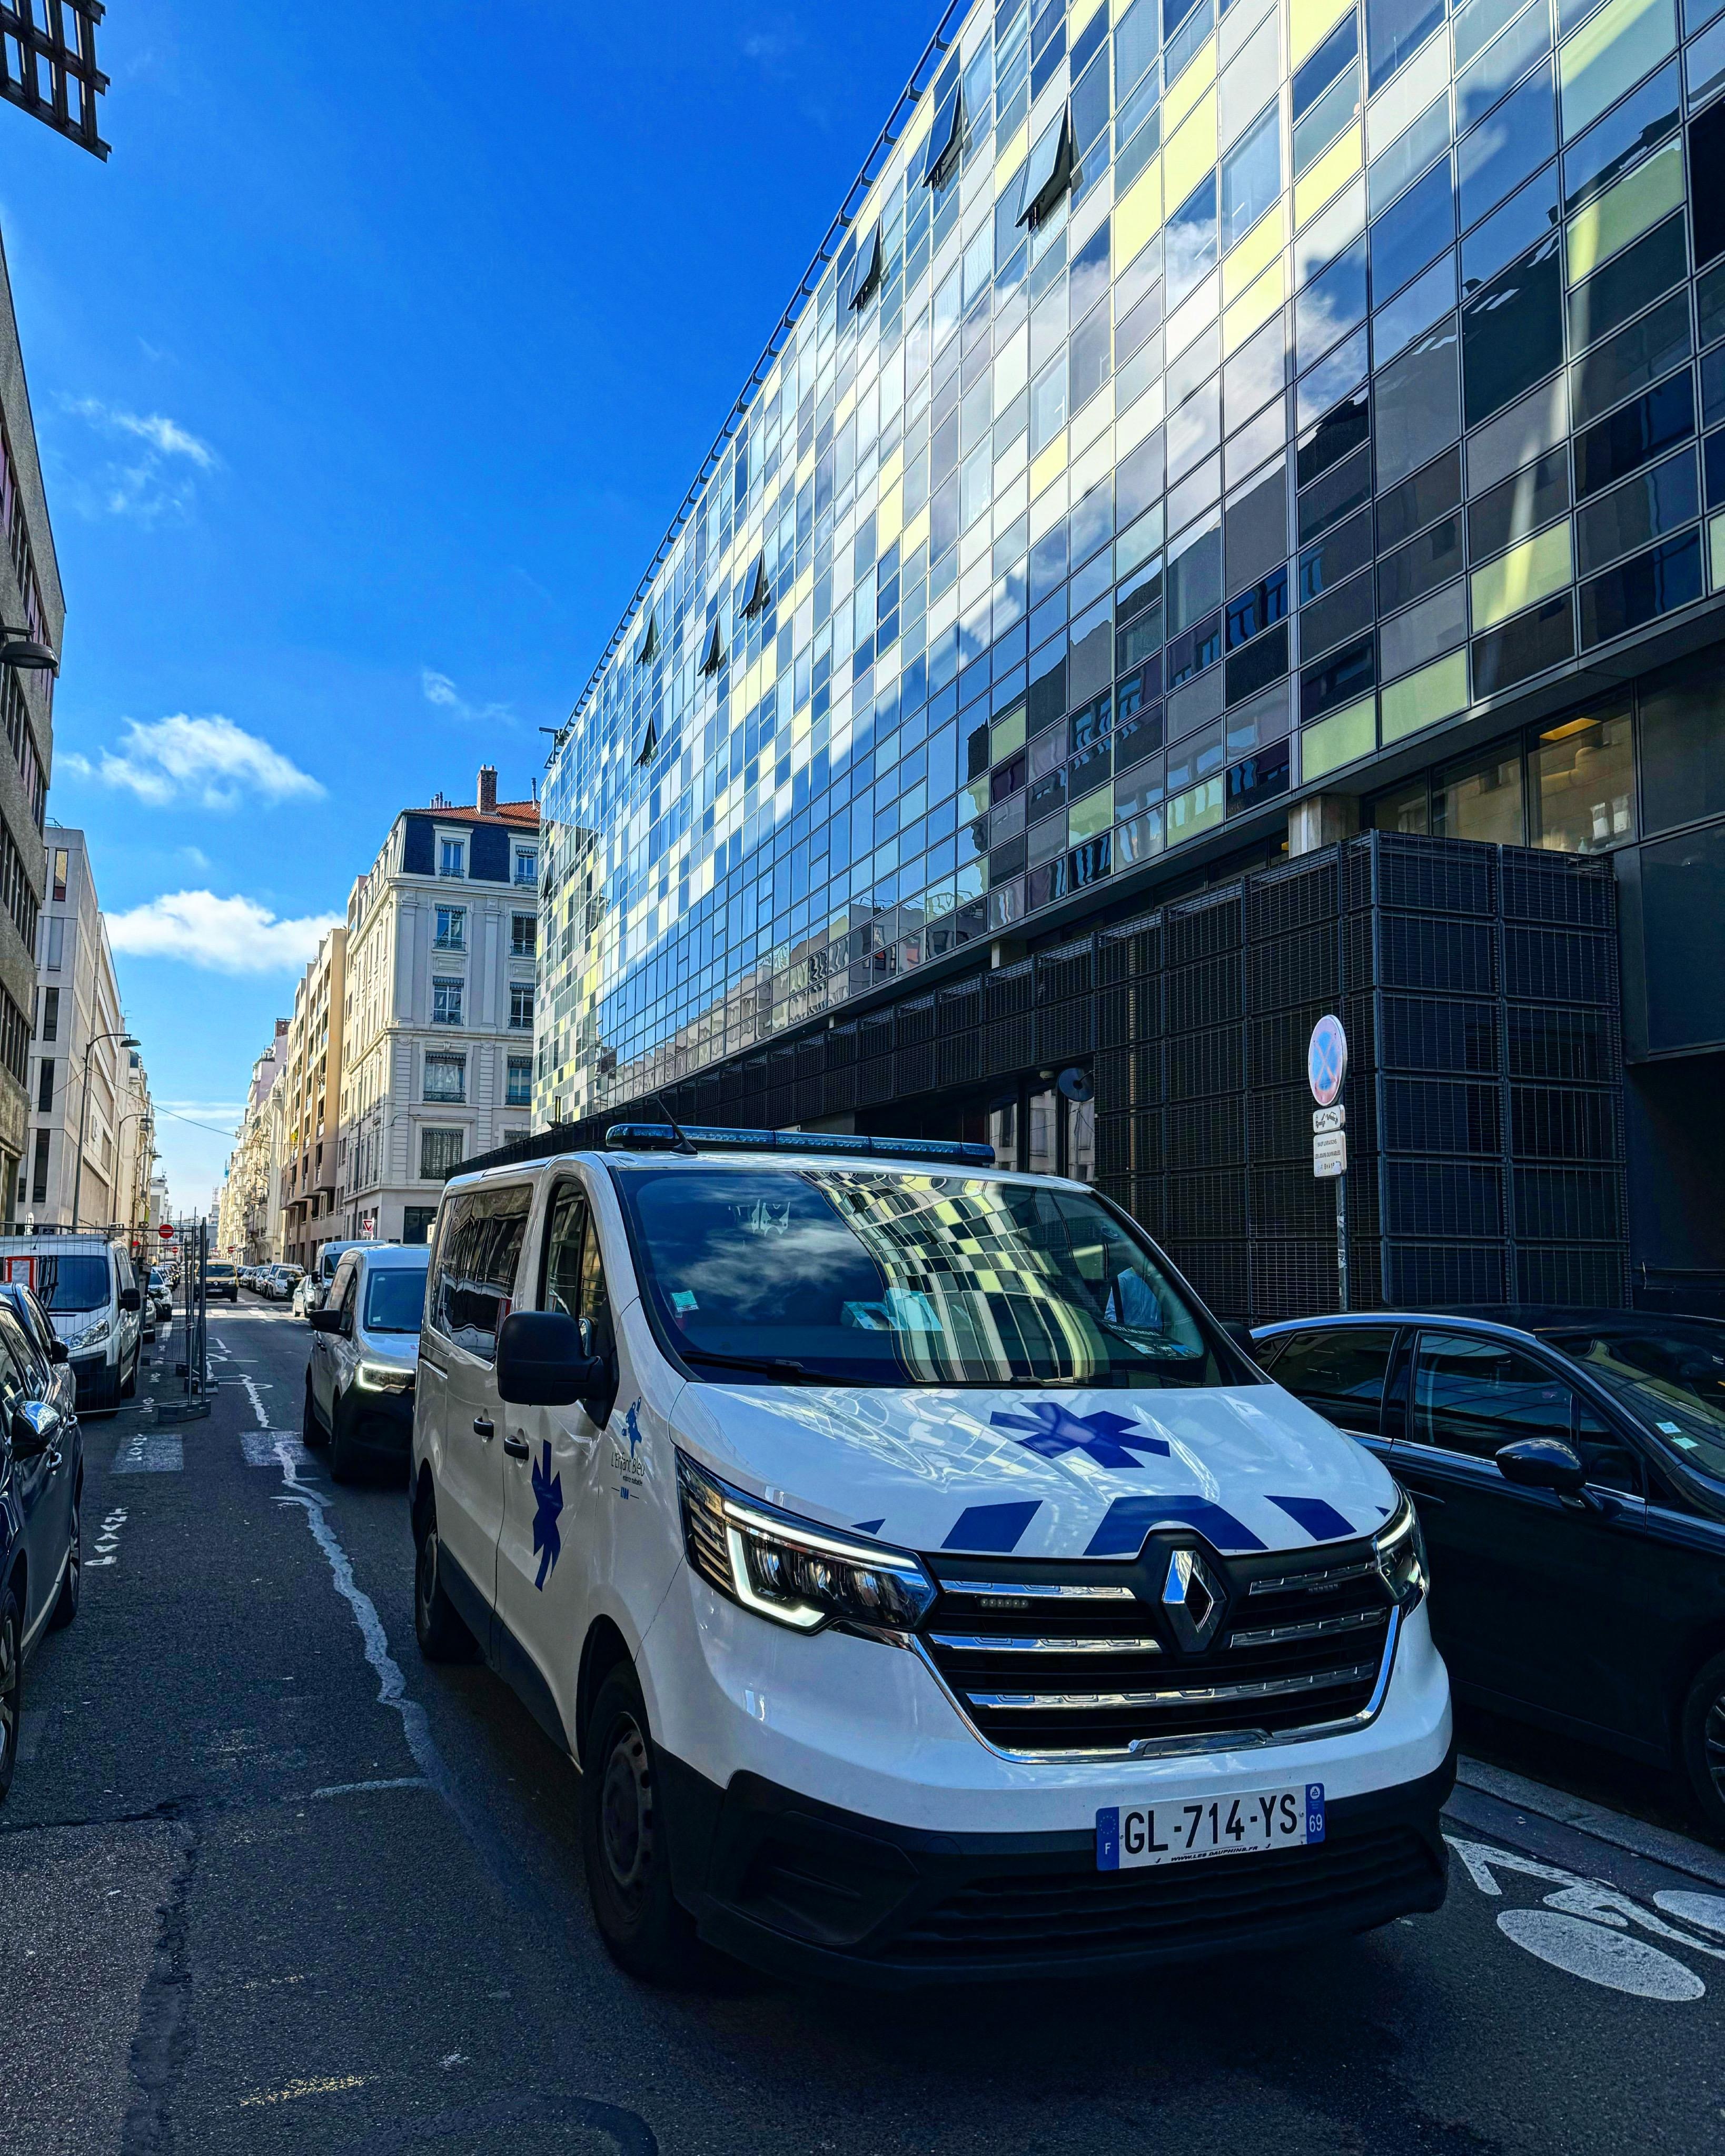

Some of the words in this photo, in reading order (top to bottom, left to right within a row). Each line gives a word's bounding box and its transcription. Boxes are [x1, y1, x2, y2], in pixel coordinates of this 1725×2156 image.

[632, 1457, 645, 1477] Bleu
[1124, 1794, 1297, 1854] GL-714-YS
[1309, 1813, 1323, 1833] 69
[1105, 1843, 1111, 1854] F
